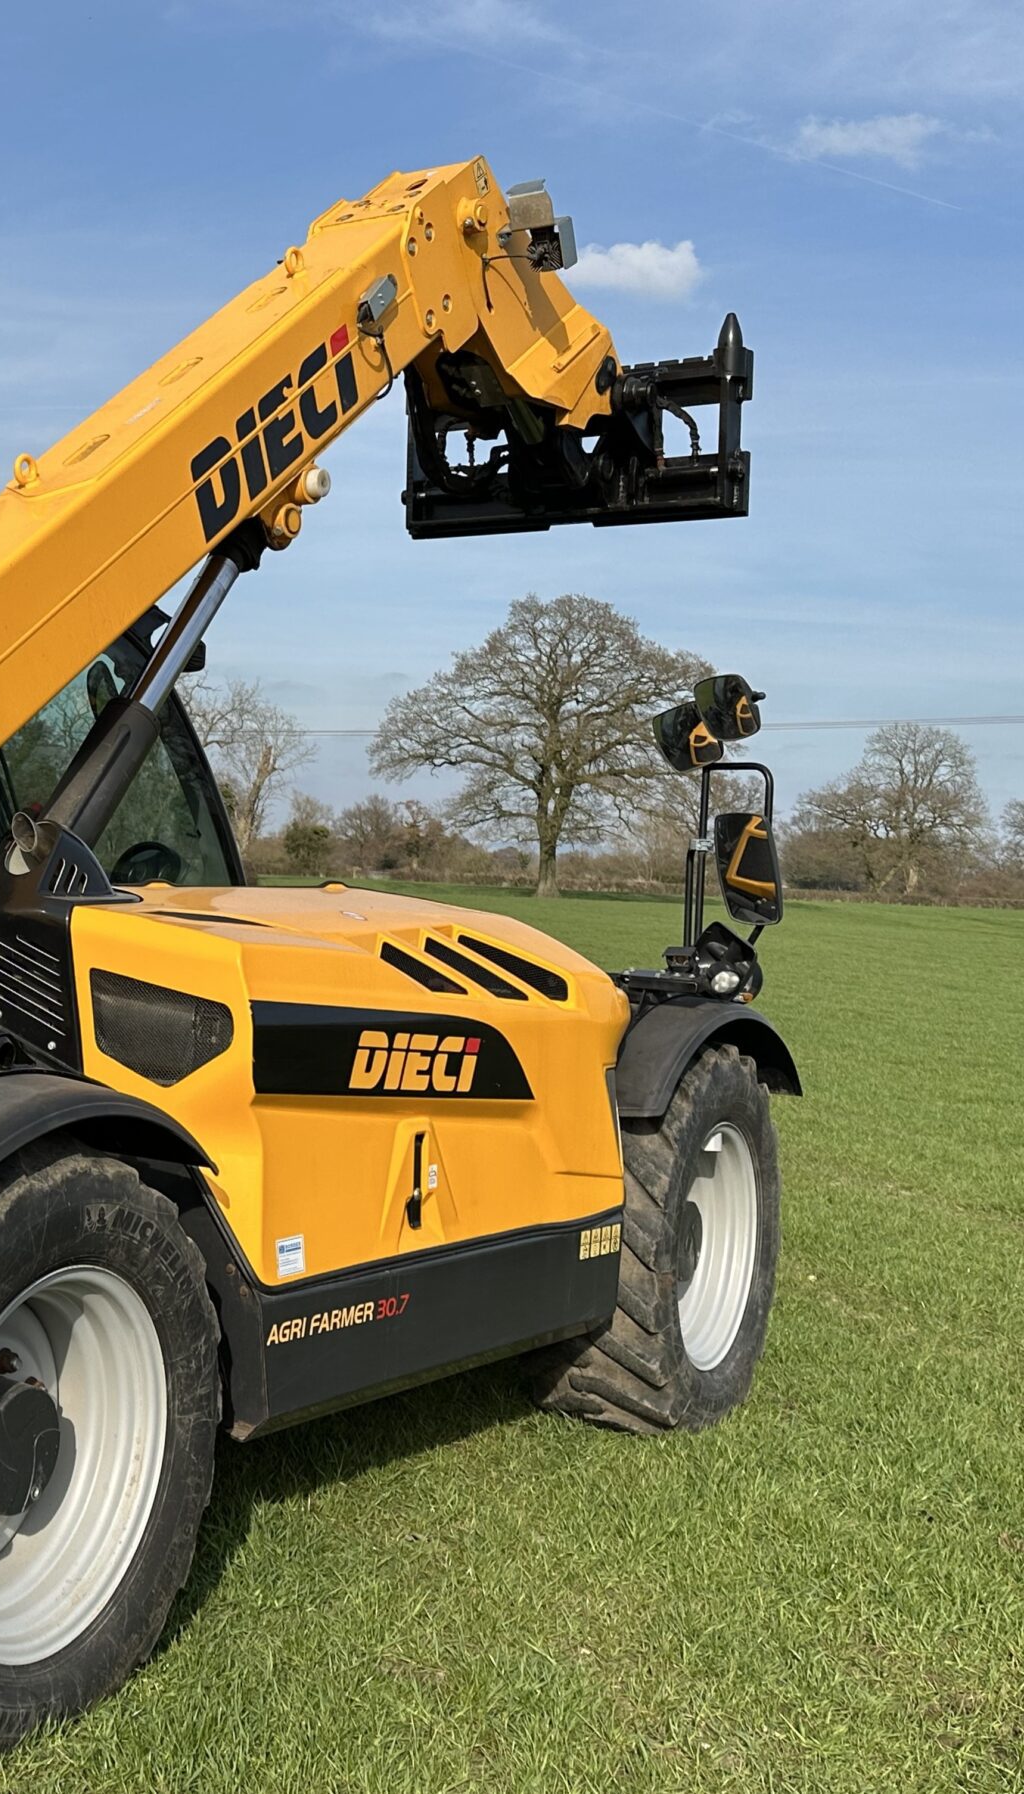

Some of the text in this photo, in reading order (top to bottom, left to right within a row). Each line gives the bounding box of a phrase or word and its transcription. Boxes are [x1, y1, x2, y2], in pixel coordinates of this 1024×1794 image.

[348, 1030, 481, 1093] DIECI
[266, 1294, 410, 1346] AGRI FARMER 30.7
